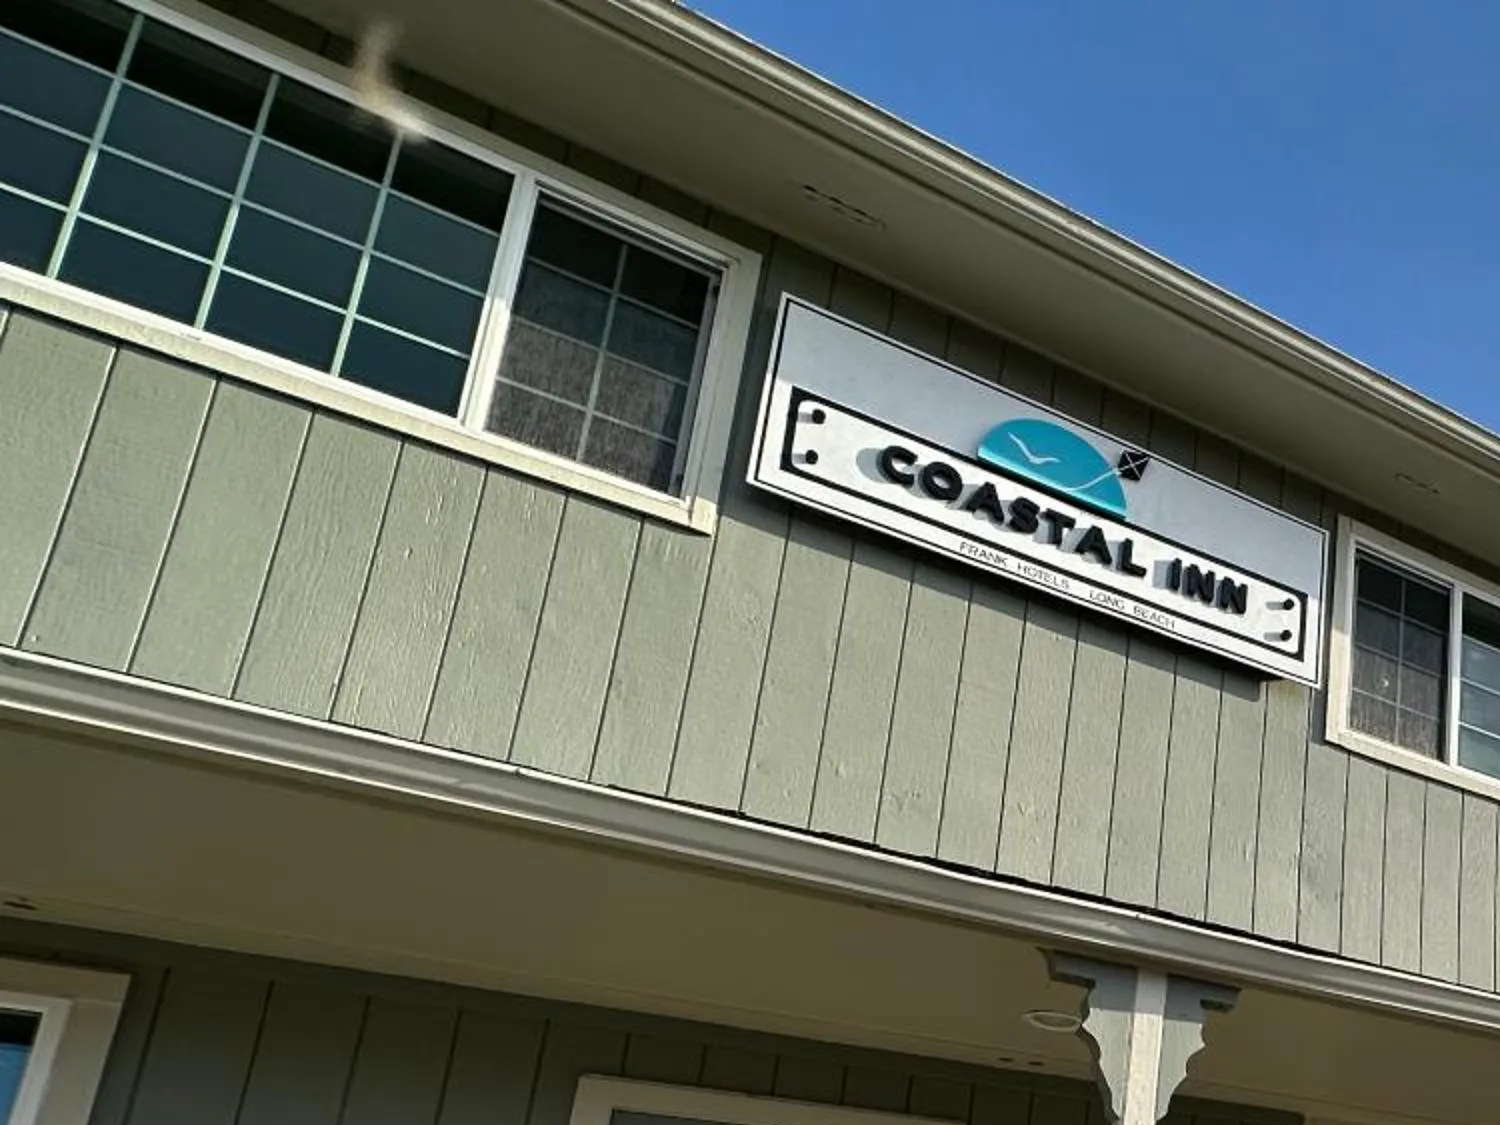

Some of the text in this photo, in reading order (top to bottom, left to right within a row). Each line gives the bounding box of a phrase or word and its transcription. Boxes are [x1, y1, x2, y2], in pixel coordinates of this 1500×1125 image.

[875, 444, 1249, 616] COASTAL INN
[959, 541, 1176, 630] FRANK HOTELS LONG BEACH
